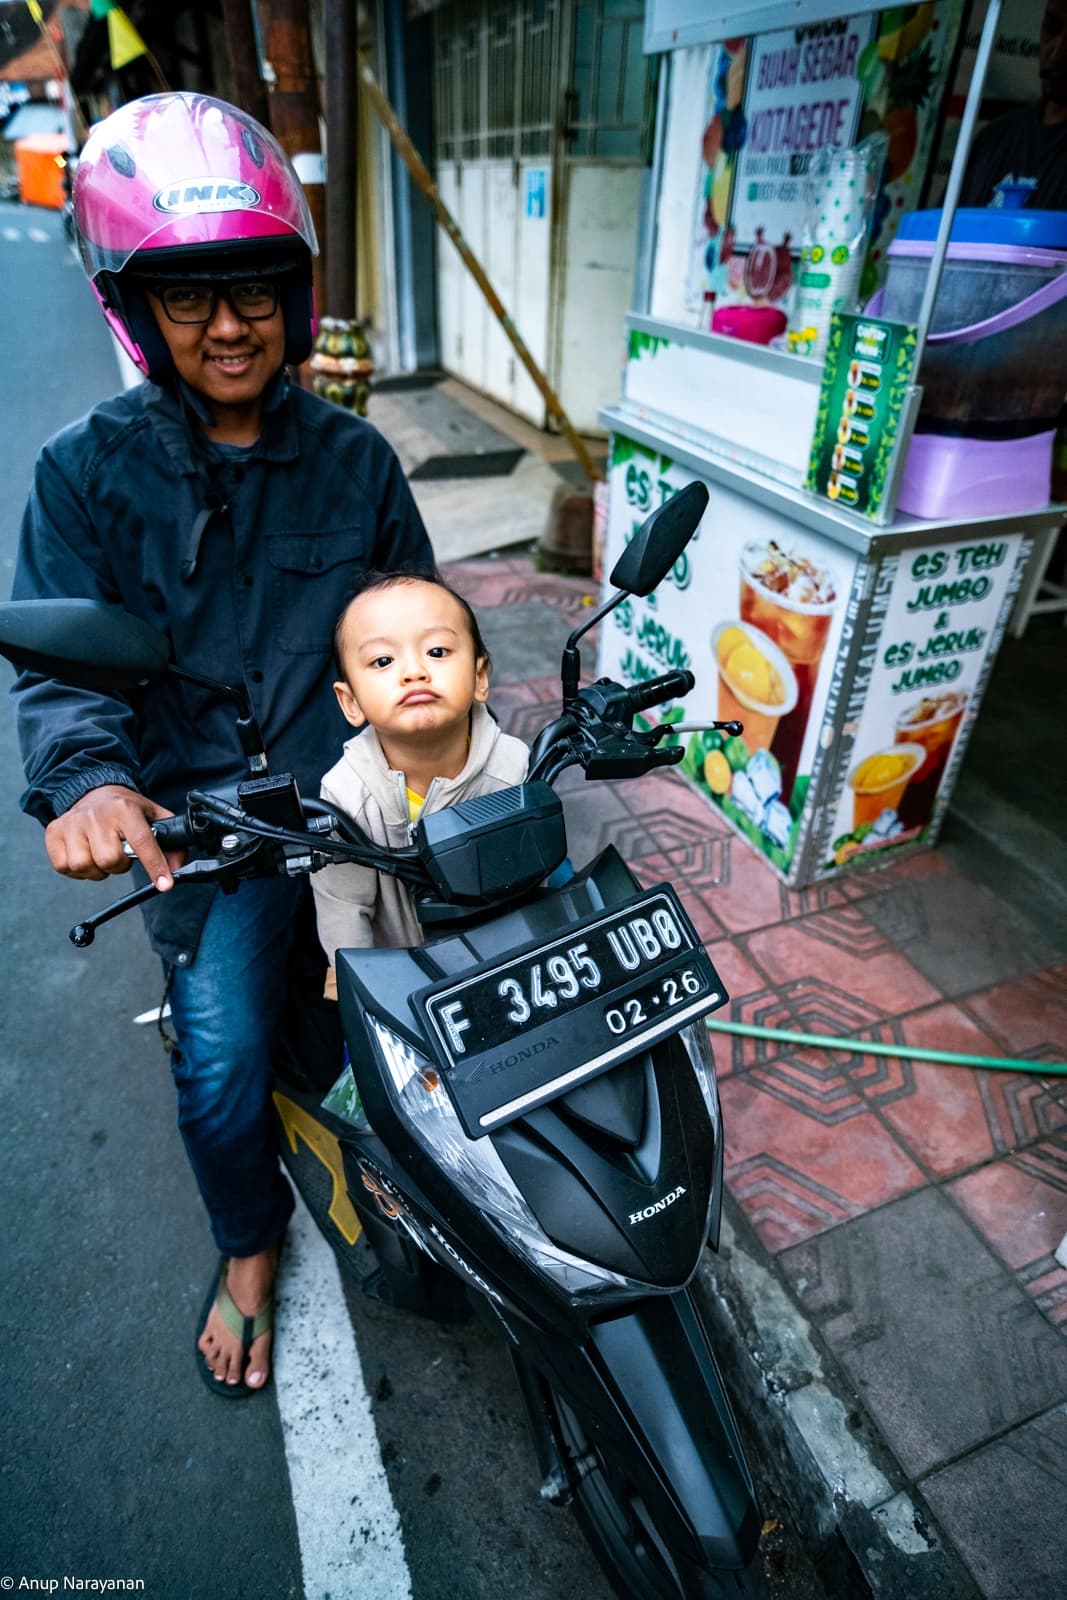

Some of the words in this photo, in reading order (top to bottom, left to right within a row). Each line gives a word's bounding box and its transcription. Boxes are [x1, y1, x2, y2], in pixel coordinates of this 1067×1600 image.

[749, 99, 849, 152] KOTAGEDE
[167, 185, 252, 206] INK
[906, 576, 989, 609] JUMBO
[934, 611, 947, 630] &
[892, 659, 960, 690] JUMBO
[440, 1000, 471, 1053] F
[498, 943, 601, 1023] 3495
[489, 1037, 560, 1074] HONDA
[628, 1185, 687, 1225] HONDA
[429, 1223, 505, 1306] HONDA
